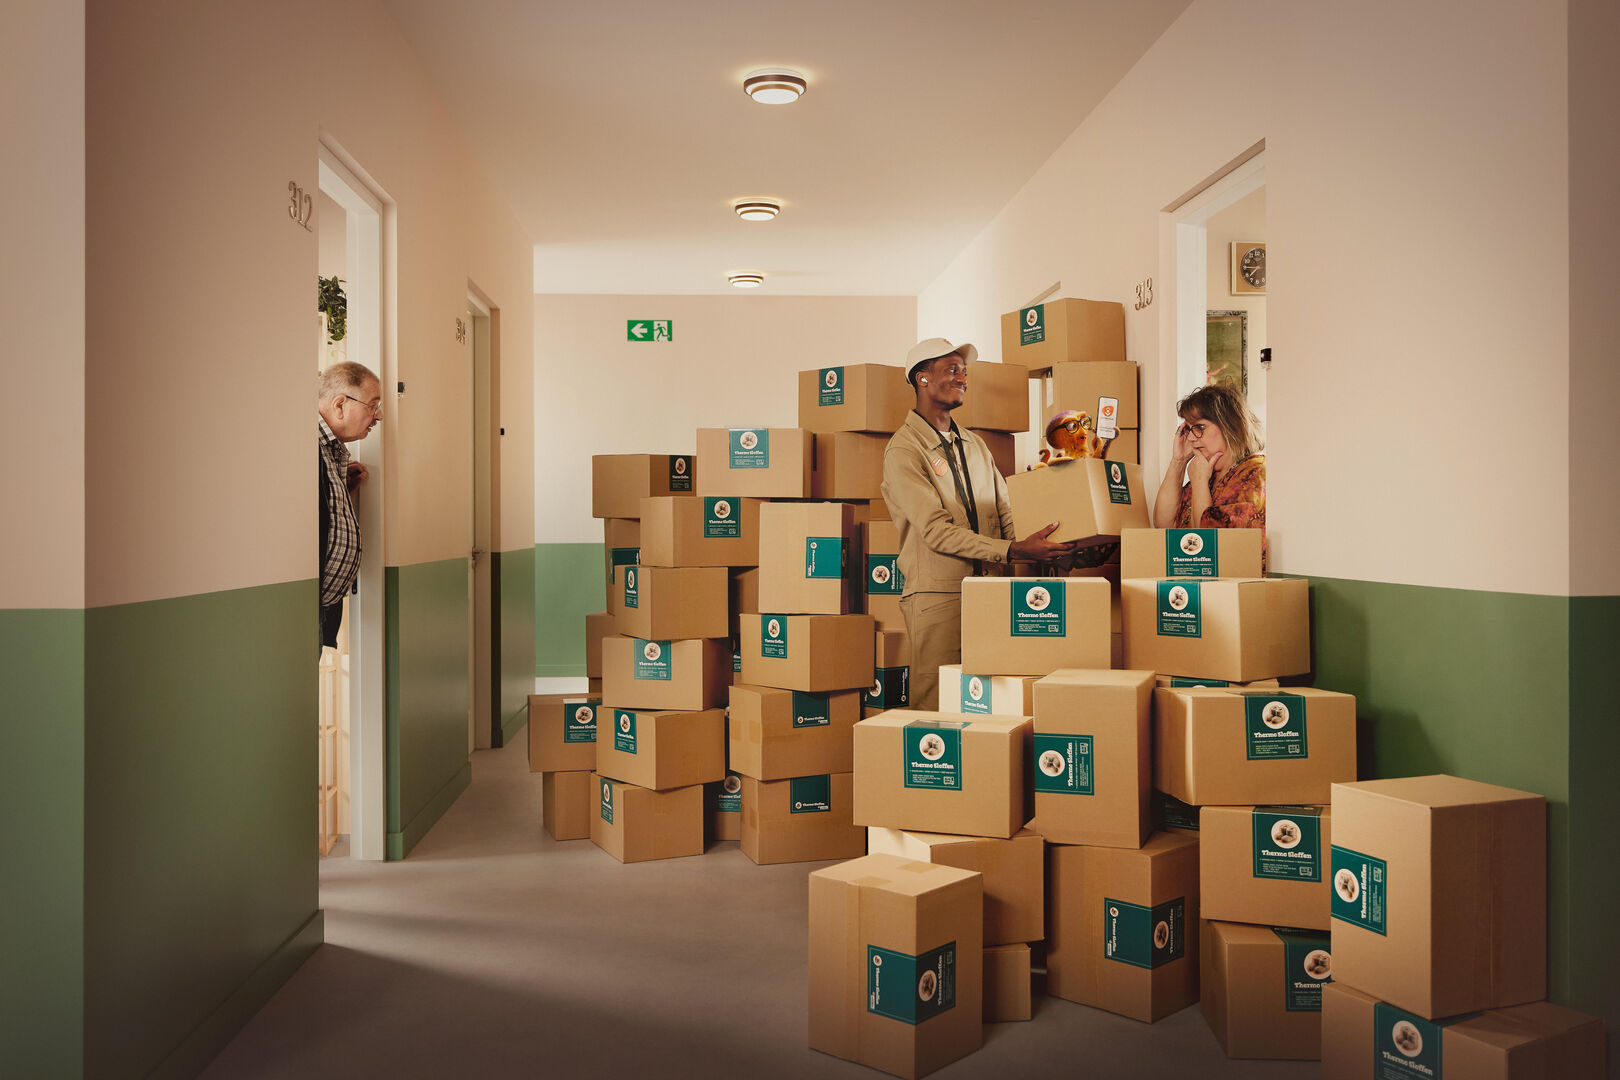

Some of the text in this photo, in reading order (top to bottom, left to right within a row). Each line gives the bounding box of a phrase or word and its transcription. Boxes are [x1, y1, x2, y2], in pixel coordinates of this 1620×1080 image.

[288, 180, 313, 233] 312
[1134, 277, 1153, 312] 313
[1277, 730, 1299, 738] Sloffen
[1261, 849, 1312, 859] Thermo Sloffen
[1382, 1051, 1408, 1066] Thermo
[1408, 1061, 1433, 1076] Sloffen
